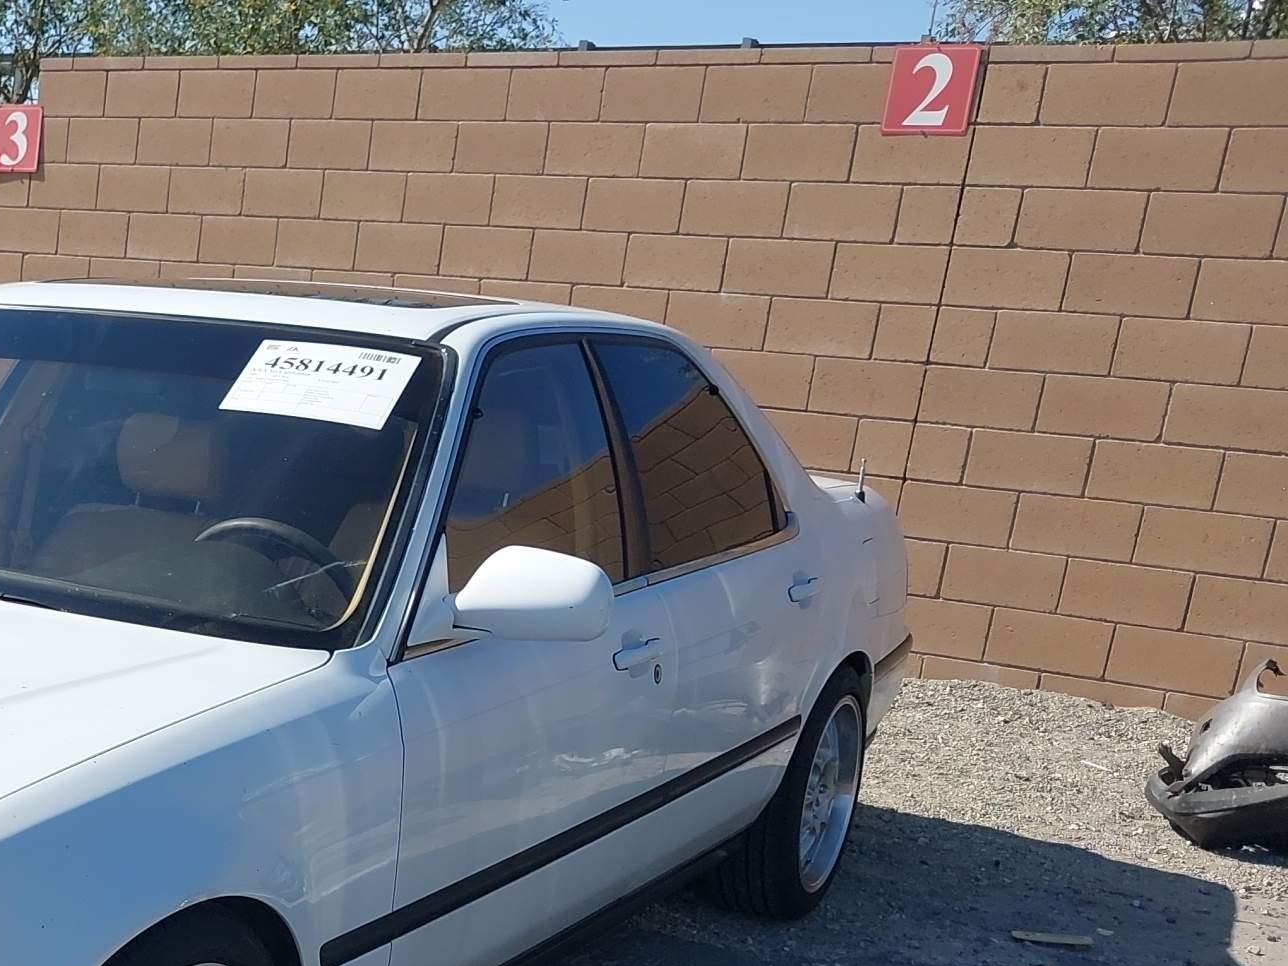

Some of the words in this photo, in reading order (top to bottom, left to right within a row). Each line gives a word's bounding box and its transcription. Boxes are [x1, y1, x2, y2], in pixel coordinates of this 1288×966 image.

[901, 52, 953, 126] 2
[0, 111, 28, 166] 3
[264, 356, 389, 381] 45814491
